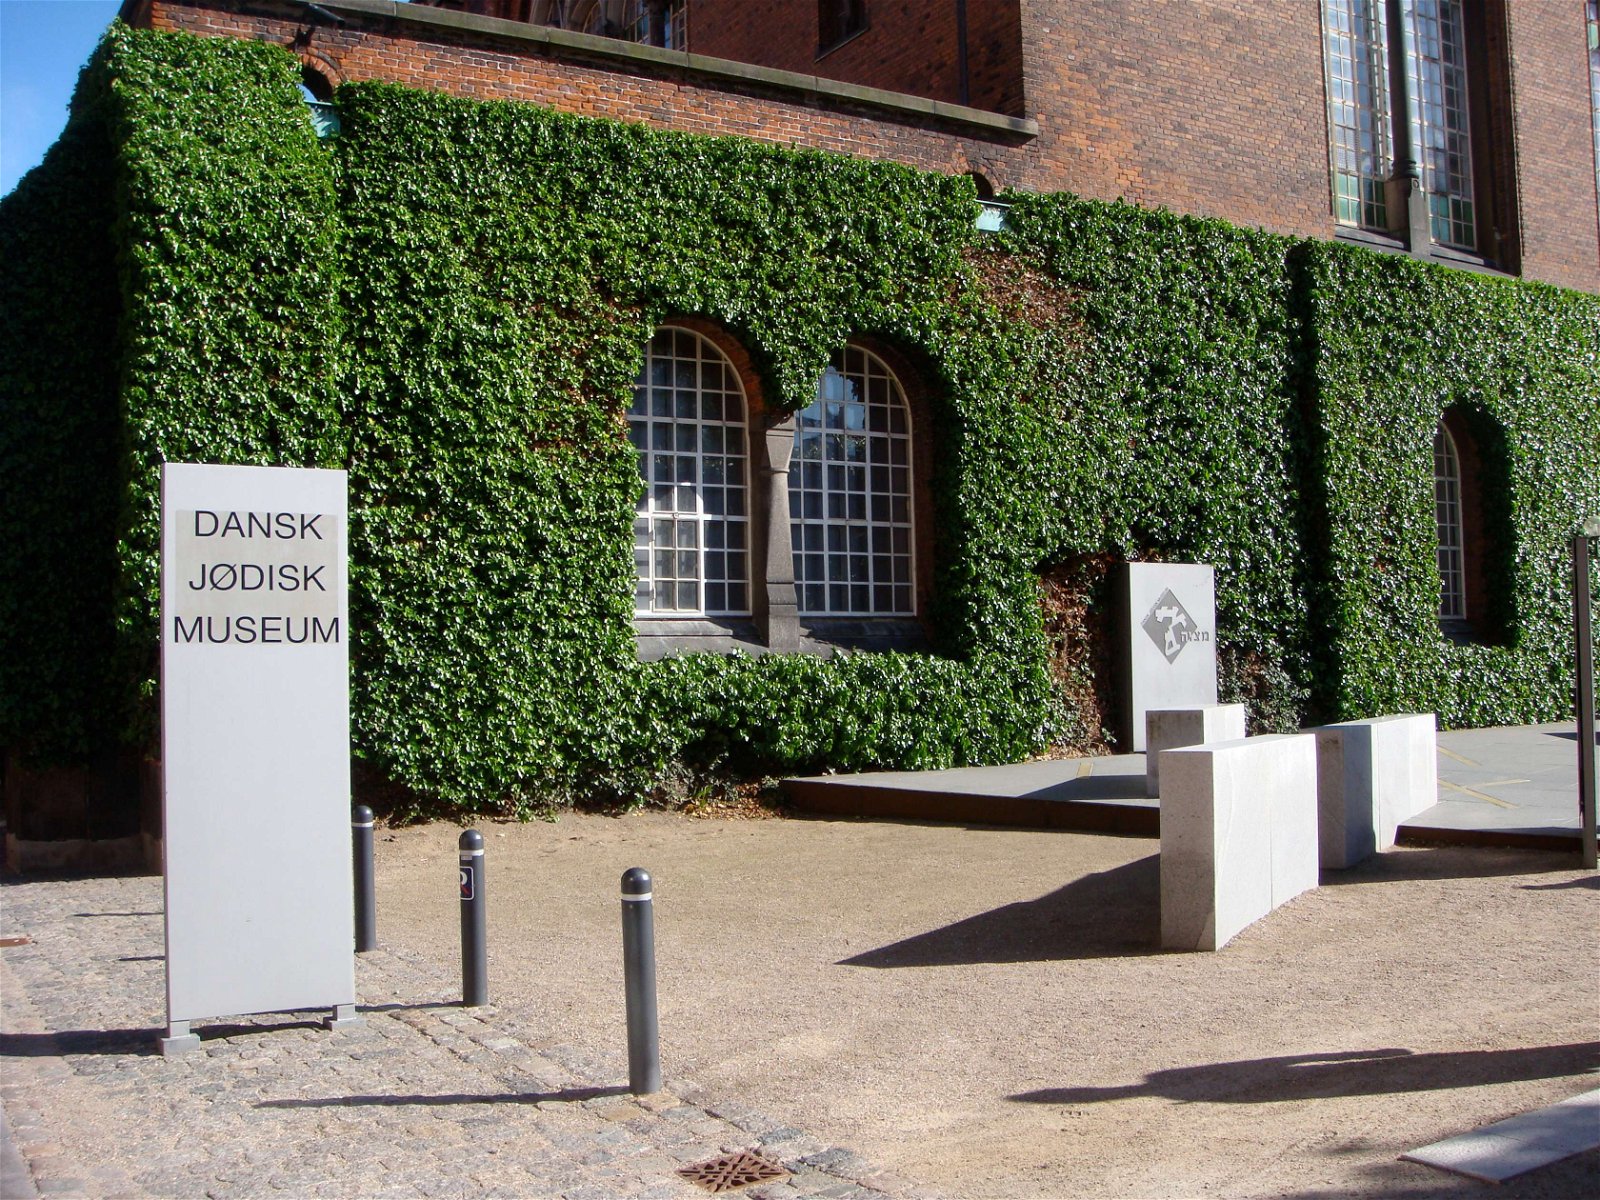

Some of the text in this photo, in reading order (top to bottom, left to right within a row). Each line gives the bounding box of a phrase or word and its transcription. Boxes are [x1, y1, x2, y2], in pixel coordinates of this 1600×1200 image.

[194, 510, 323, 540] DANSK
[189, 563, 326, 591] JØDISK
[174, 616, 340, 643] MUSEUM
